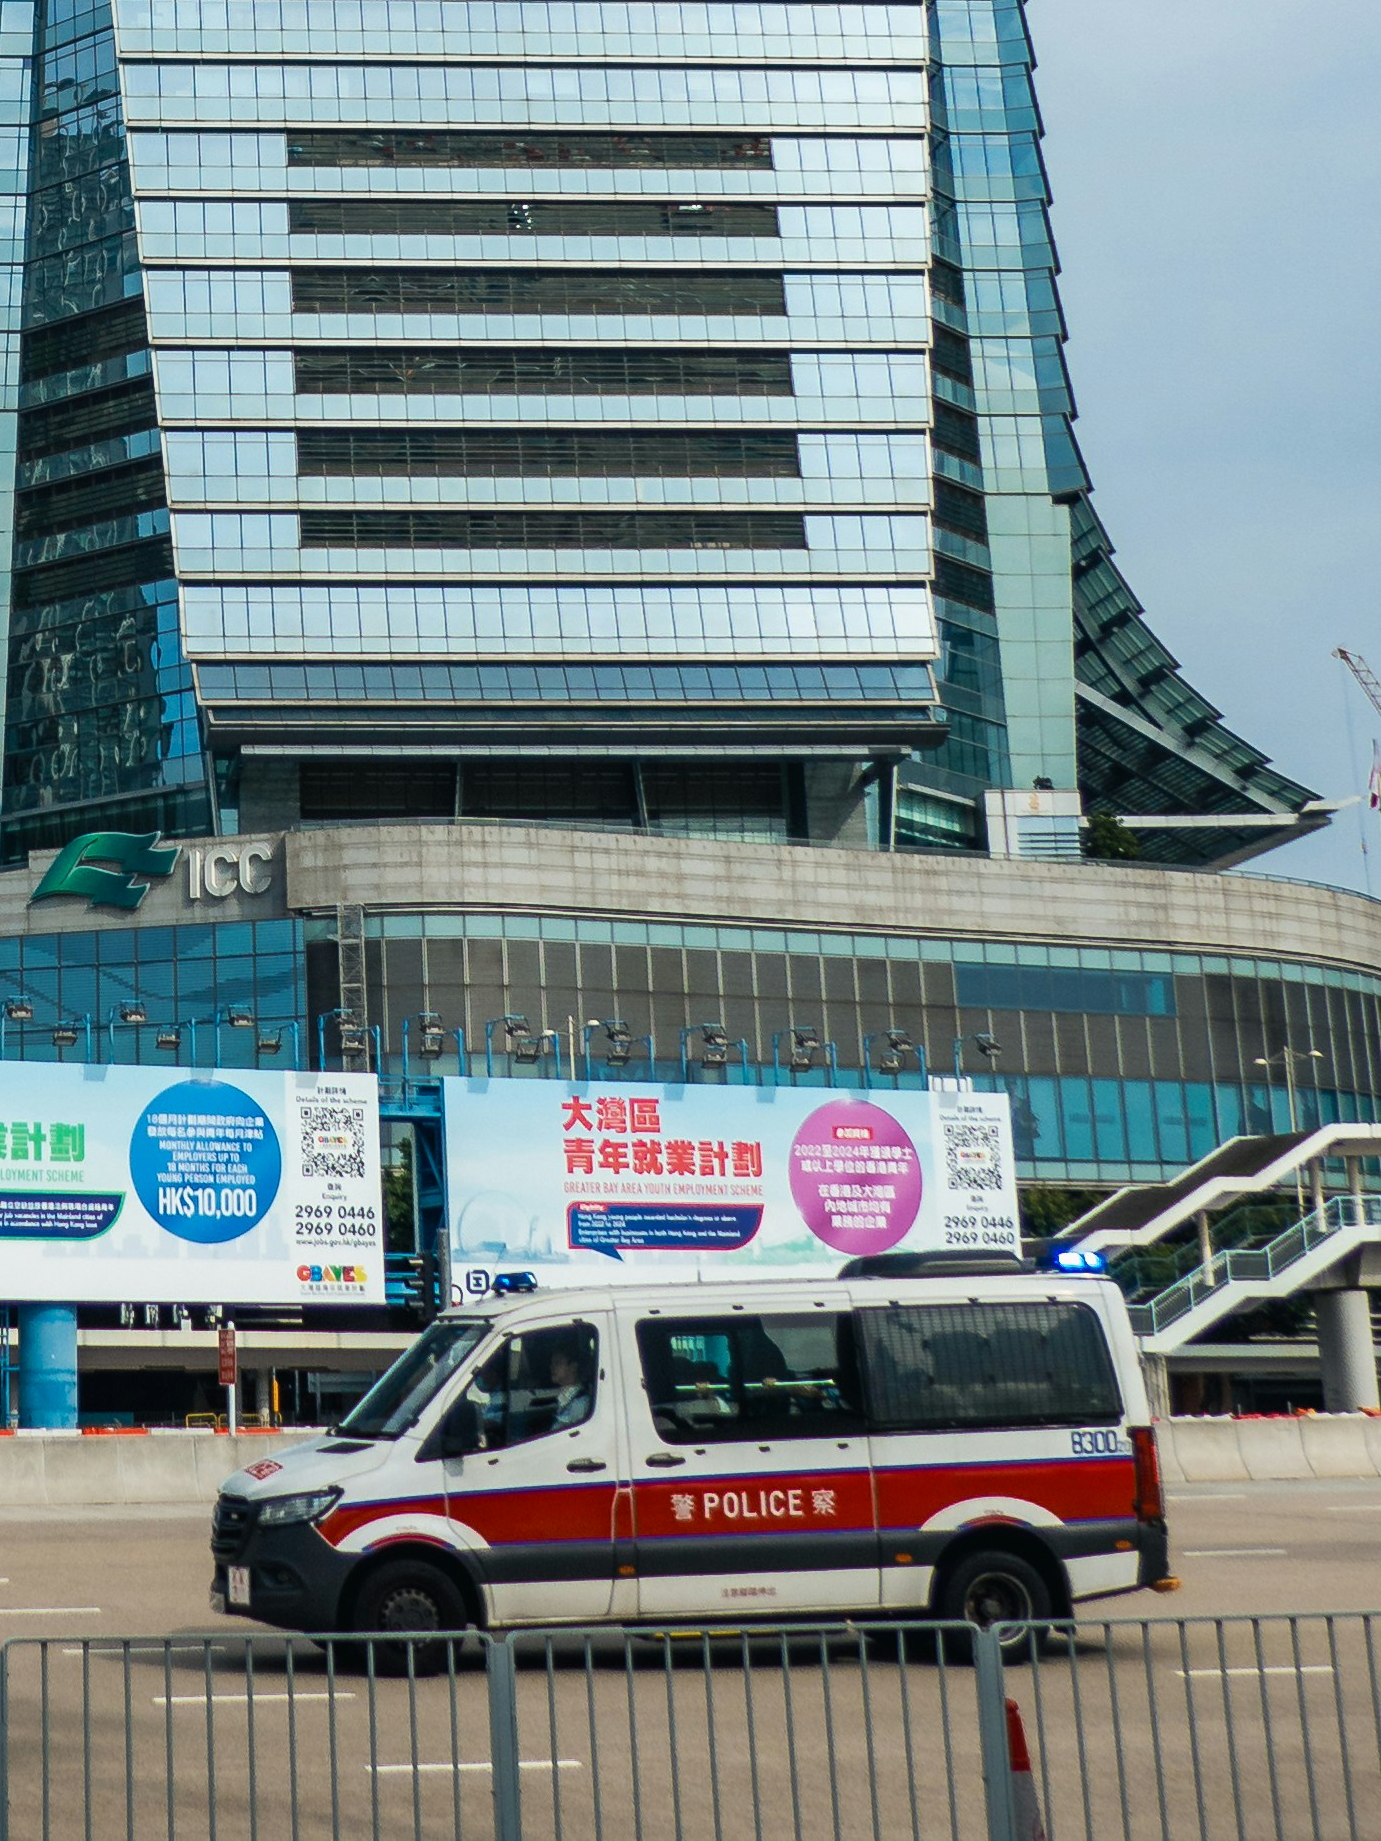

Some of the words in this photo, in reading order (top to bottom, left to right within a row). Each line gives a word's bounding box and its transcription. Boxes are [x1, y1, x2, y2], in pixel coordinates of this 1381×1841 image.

[189, 843, 273, 899] ICC
[561, 1094, 661, 1134] 大灣區
[159, 1140, 194, 1150] MONTHLY
[196, 1141, 241, 1152] ALLOWANCE
[243, 1142, 253, 1152] TO
[173, 1152, 217, 1162] EMPLOYERS
[218, 1153, 229, 1162] UP
[230, 1153, 240, 1162] TO
[563, 1136, 763, 1177] 青年就業計劃
[168, 1162, 177, 1172] 18
[178, 1163, 210, 1172] MONTHS
[211, 1163, 226, 1173] FOR
[228, 1163, 248, 1173] EACH
[46, 1169, 85, 1183] SCHEME
[157, 1172, 182, 1183] YOUNG
[184, 1173, 214, 1184] PERSON
[216, 1174, 256, 1185] EMPLOYED
[564, 1181, 601, 1194] GREATER
[603, 1182, 619, 1194] BAY
[621, 1182, 643, 1194] AREA
[644, 1182, 671, 1195] YOUTH
[673, 1183, 728, 1195] EMPLOYMENT
[730, 1184, 763, 1196] SCHEME
[158, 1185, 257, 1219] HK$10,000
[295, 1205, 332, 1218] 2969
[338, 1205, 375, 1219] 0446
[295, 1222, 333, 1235] 2969
[338, 1222, 376, 1236] 0460
[944, 1215, 977, 1228] 2969
[981, 1216, 1014, 1229] 0446
[945, 1231, 978, 1244] 2969
[982, 1231, 1015, 1245] 0460
[671, 1493, 695, 1520] 警
[702, 1489, 804, 1519] POLICE
[811, 1488, 836, 1516] 察
